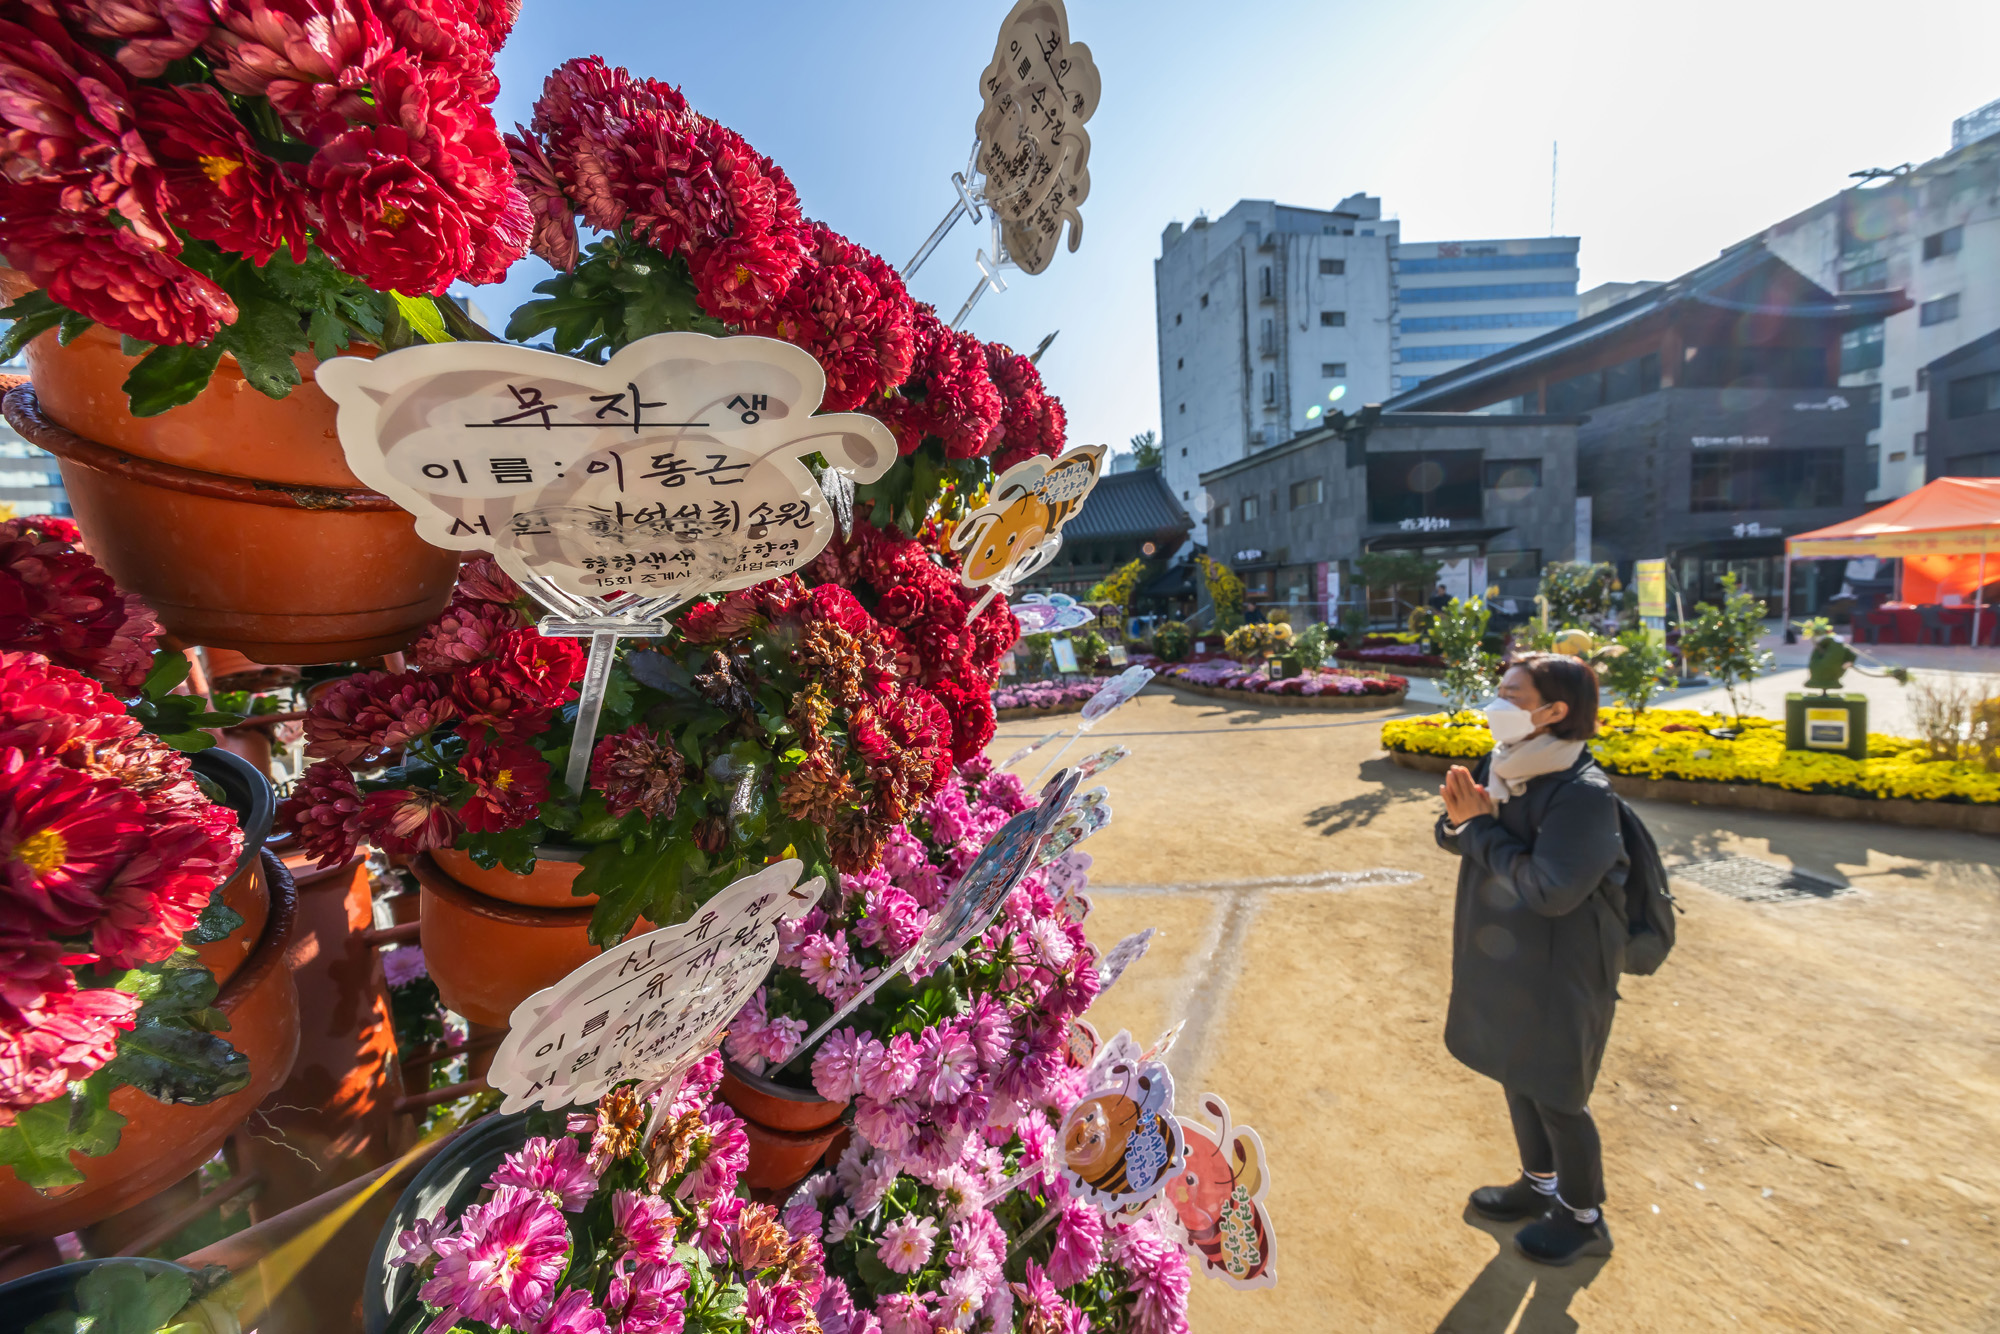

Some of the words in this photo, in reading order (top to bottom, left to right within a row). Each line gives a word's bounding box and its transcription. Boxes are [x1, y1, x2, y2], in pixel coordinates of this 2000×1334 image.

[726, 394, 768, 425] 생
[585, 450, 752, 493] 이동근
[1033, 461, 1089, 494] 형형색색
[1037, 478, 1088, 503] 가을향연
[581, 549, 697, 575] 형형색색
[594, 575, 633, 588] 15회
[640, 569, 694, 584] 조계사
[745, 894, 769, 916] 생
[1137, 1108, 1165, 1168] 형형색색
[1126, 1131, 1151, 1188] 가을향연
[1221, 1200, 1245, 1273] 가을향연
[1232, 1185, 1260, 1264] 형형색색
